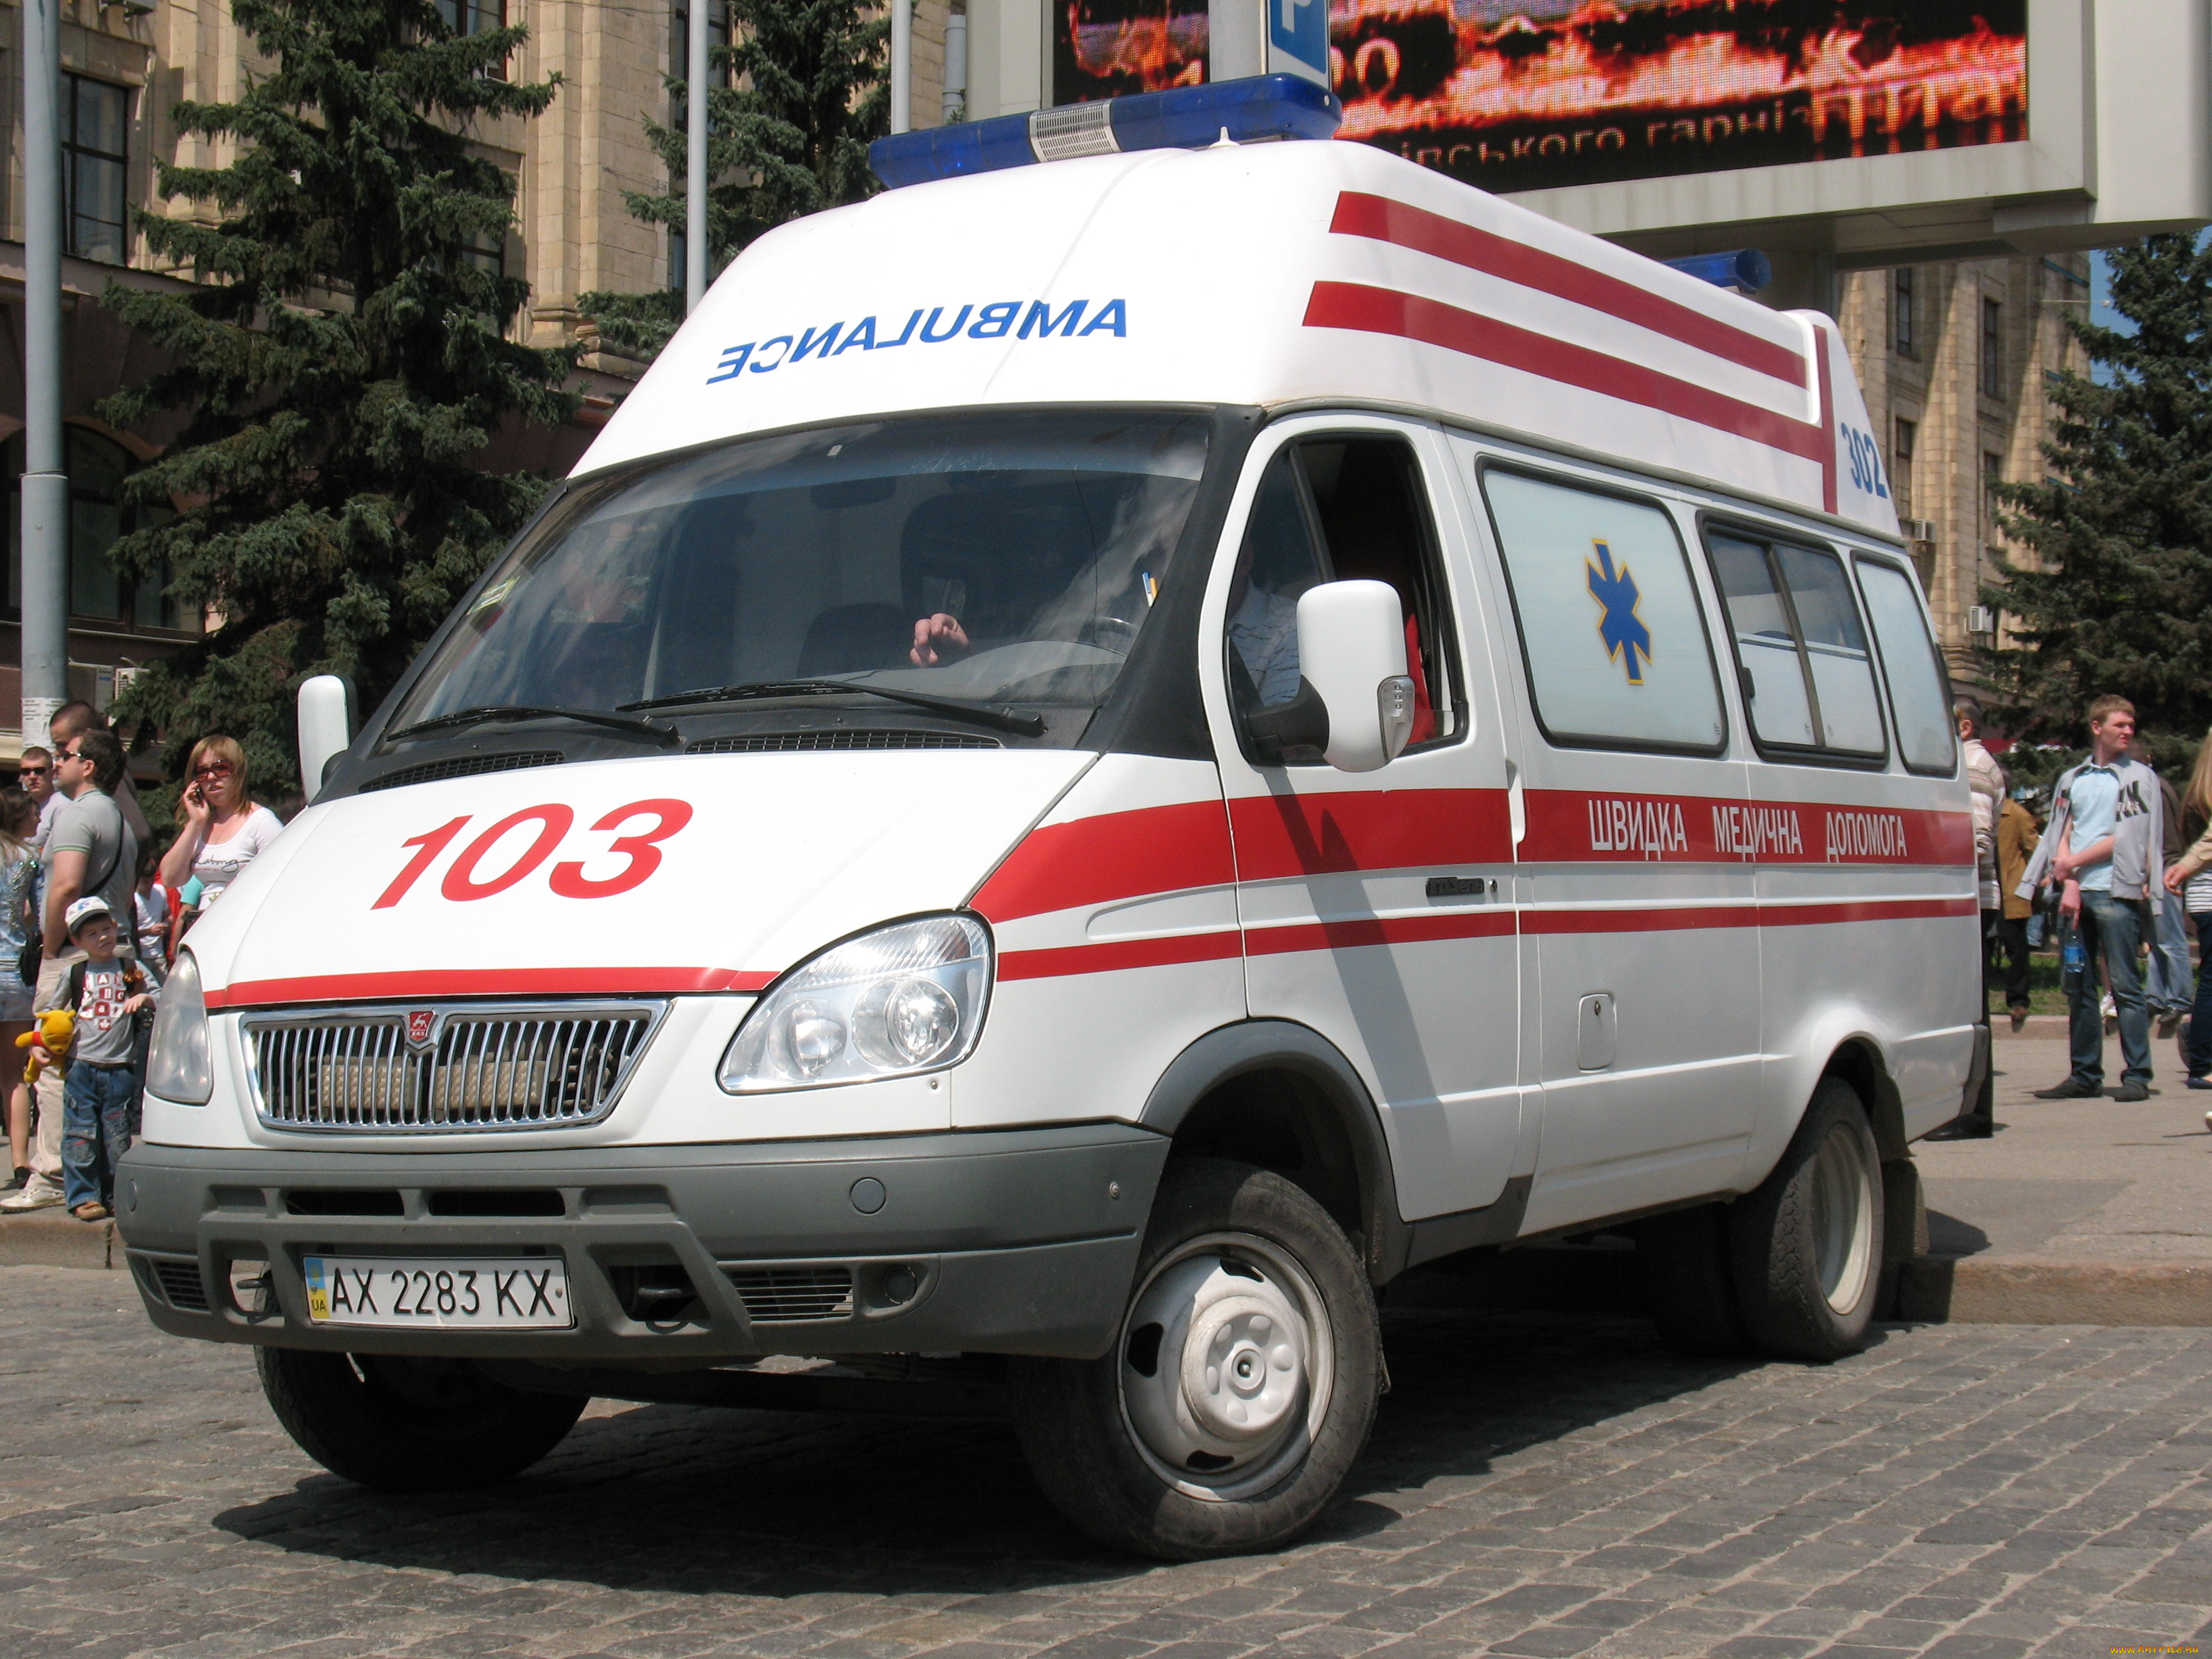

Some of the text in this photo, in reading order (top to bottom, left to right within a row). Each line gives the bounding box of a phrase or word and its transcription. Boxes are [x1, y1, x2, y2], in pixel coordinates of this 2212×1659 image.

[1841, 422, 1875, 499] 302
[369, 798, 694, 911] 103
[1588, 799, 1908, 863] ШВИДКА МЕДИЧНА ДОПОМОГА
[312, 1299, 327, 1311] UA
[331, 1267, 556, 1317] AX 2283 KX
